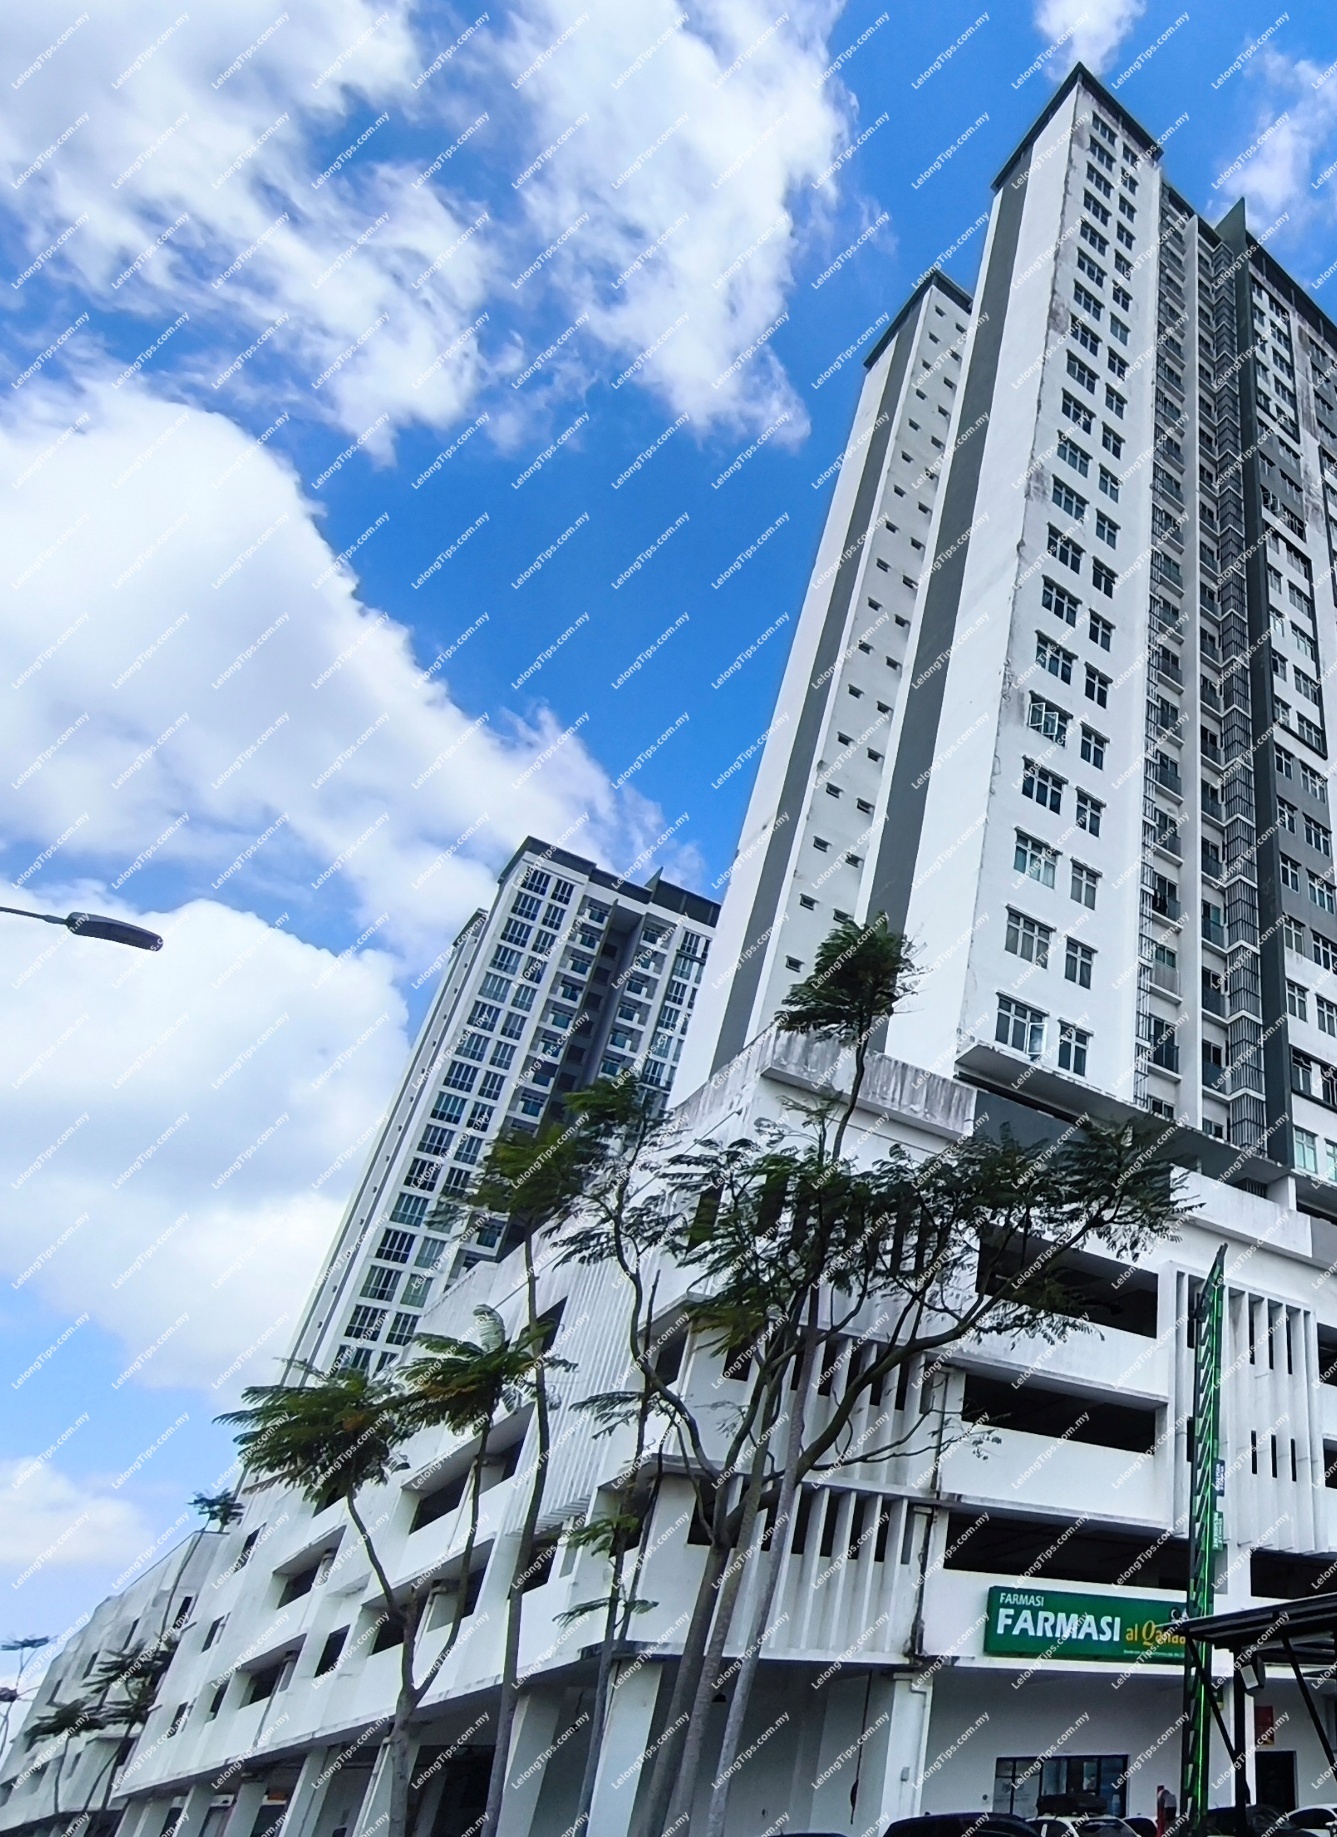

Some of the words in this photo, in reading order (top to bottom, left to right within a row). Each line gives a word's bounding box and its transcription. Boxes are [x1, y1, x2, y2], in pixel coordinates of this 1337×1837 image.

[1000, 1592, 1044, 1607] FARMASI
[996, 1607, 1121, 1642] FARMASI
[1125, 1623, 1138, 1642] al
